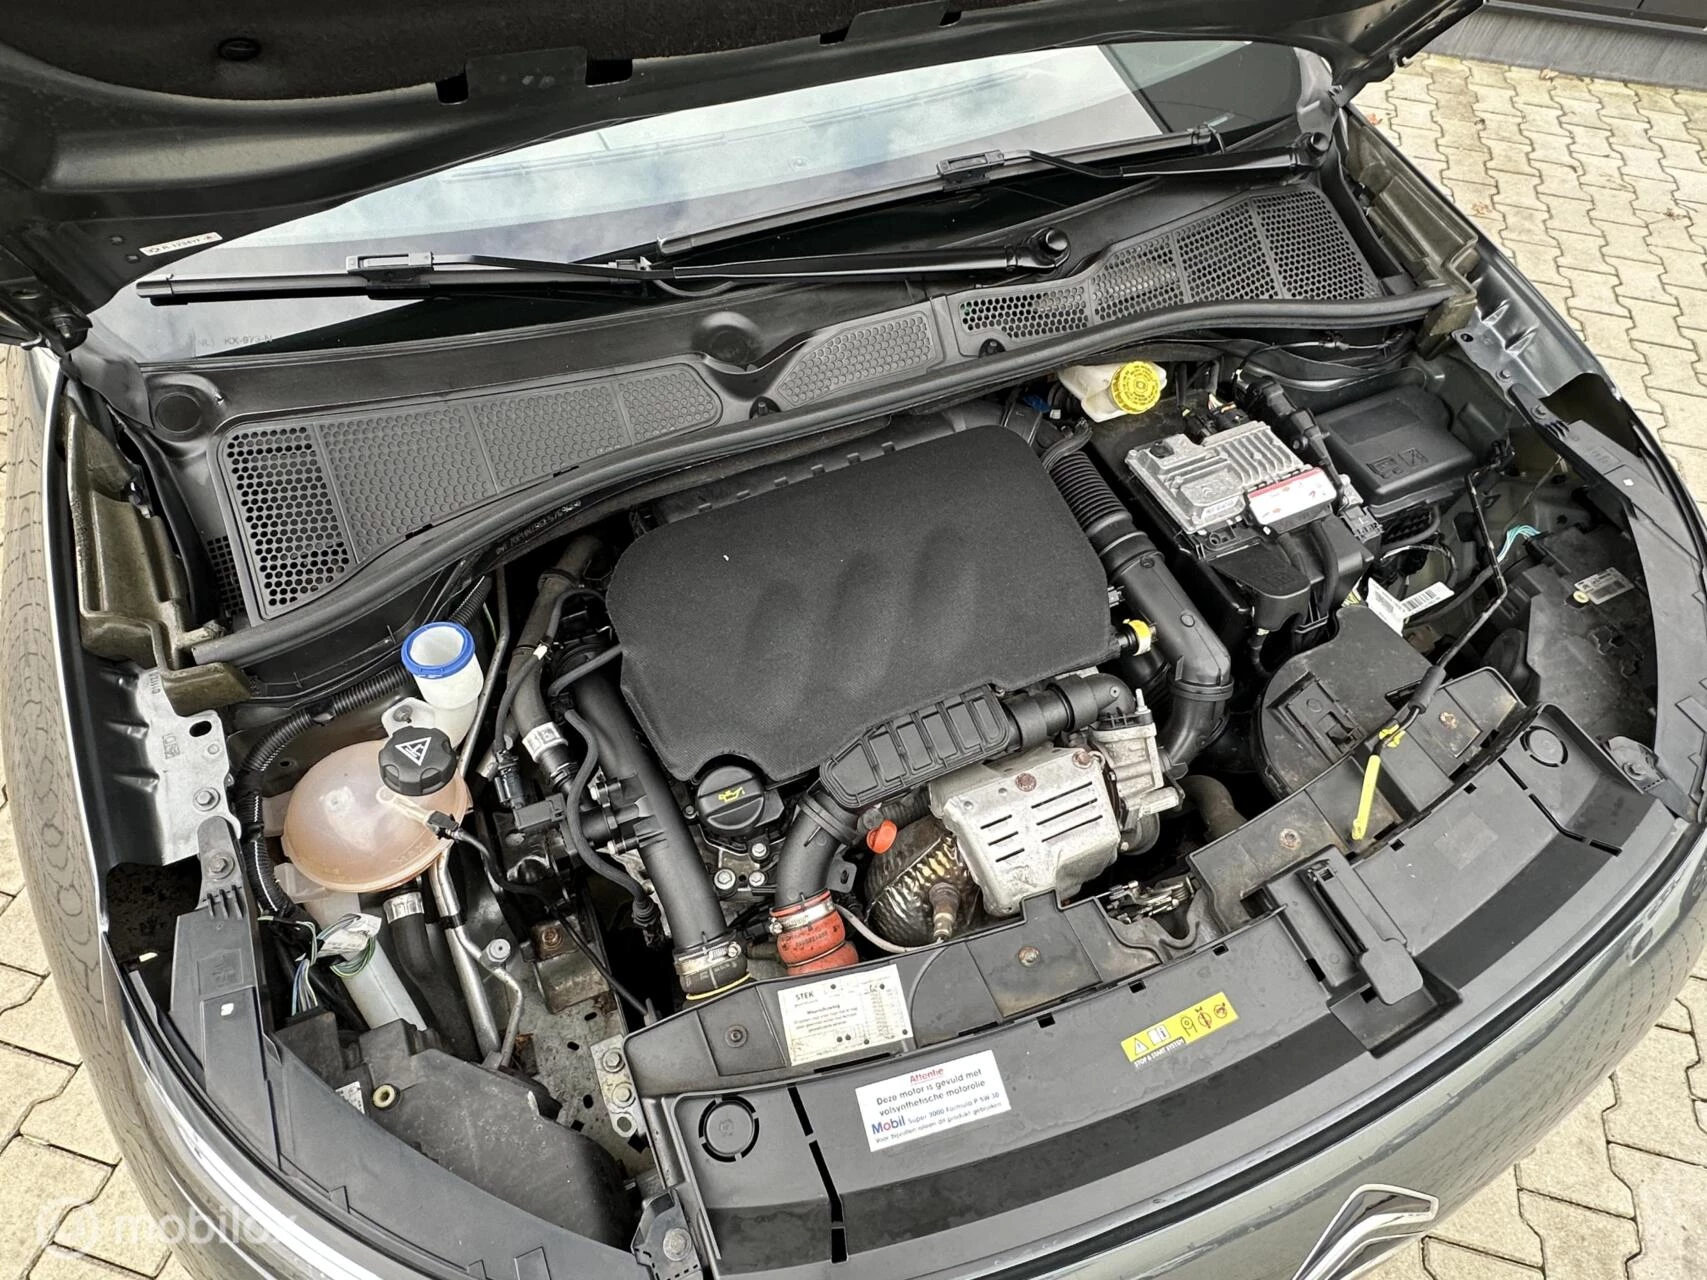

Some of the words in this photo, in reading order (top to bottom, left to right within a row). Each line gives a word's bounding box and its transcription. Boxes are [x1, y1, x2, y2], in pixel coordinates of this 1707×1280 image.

[795, 991, 814, 1001] STEK
[910, 1067, 944, 1083] Attentie
[877, 1095, 897, 1105] Deze
[899, 1087, 924, 1099] motor
[926, 1083, 933, 1091] is
[935, 1075, 964, 1090] gevuld
[966, 1069, 982, 1080] met
[880, 1093, 944, 1116] volsynthetische
[946, 1080, 985, 1096] motorolie
[871, 1115, 906, 1135] Mobil
[907, 1114, 927, 1124] Super
